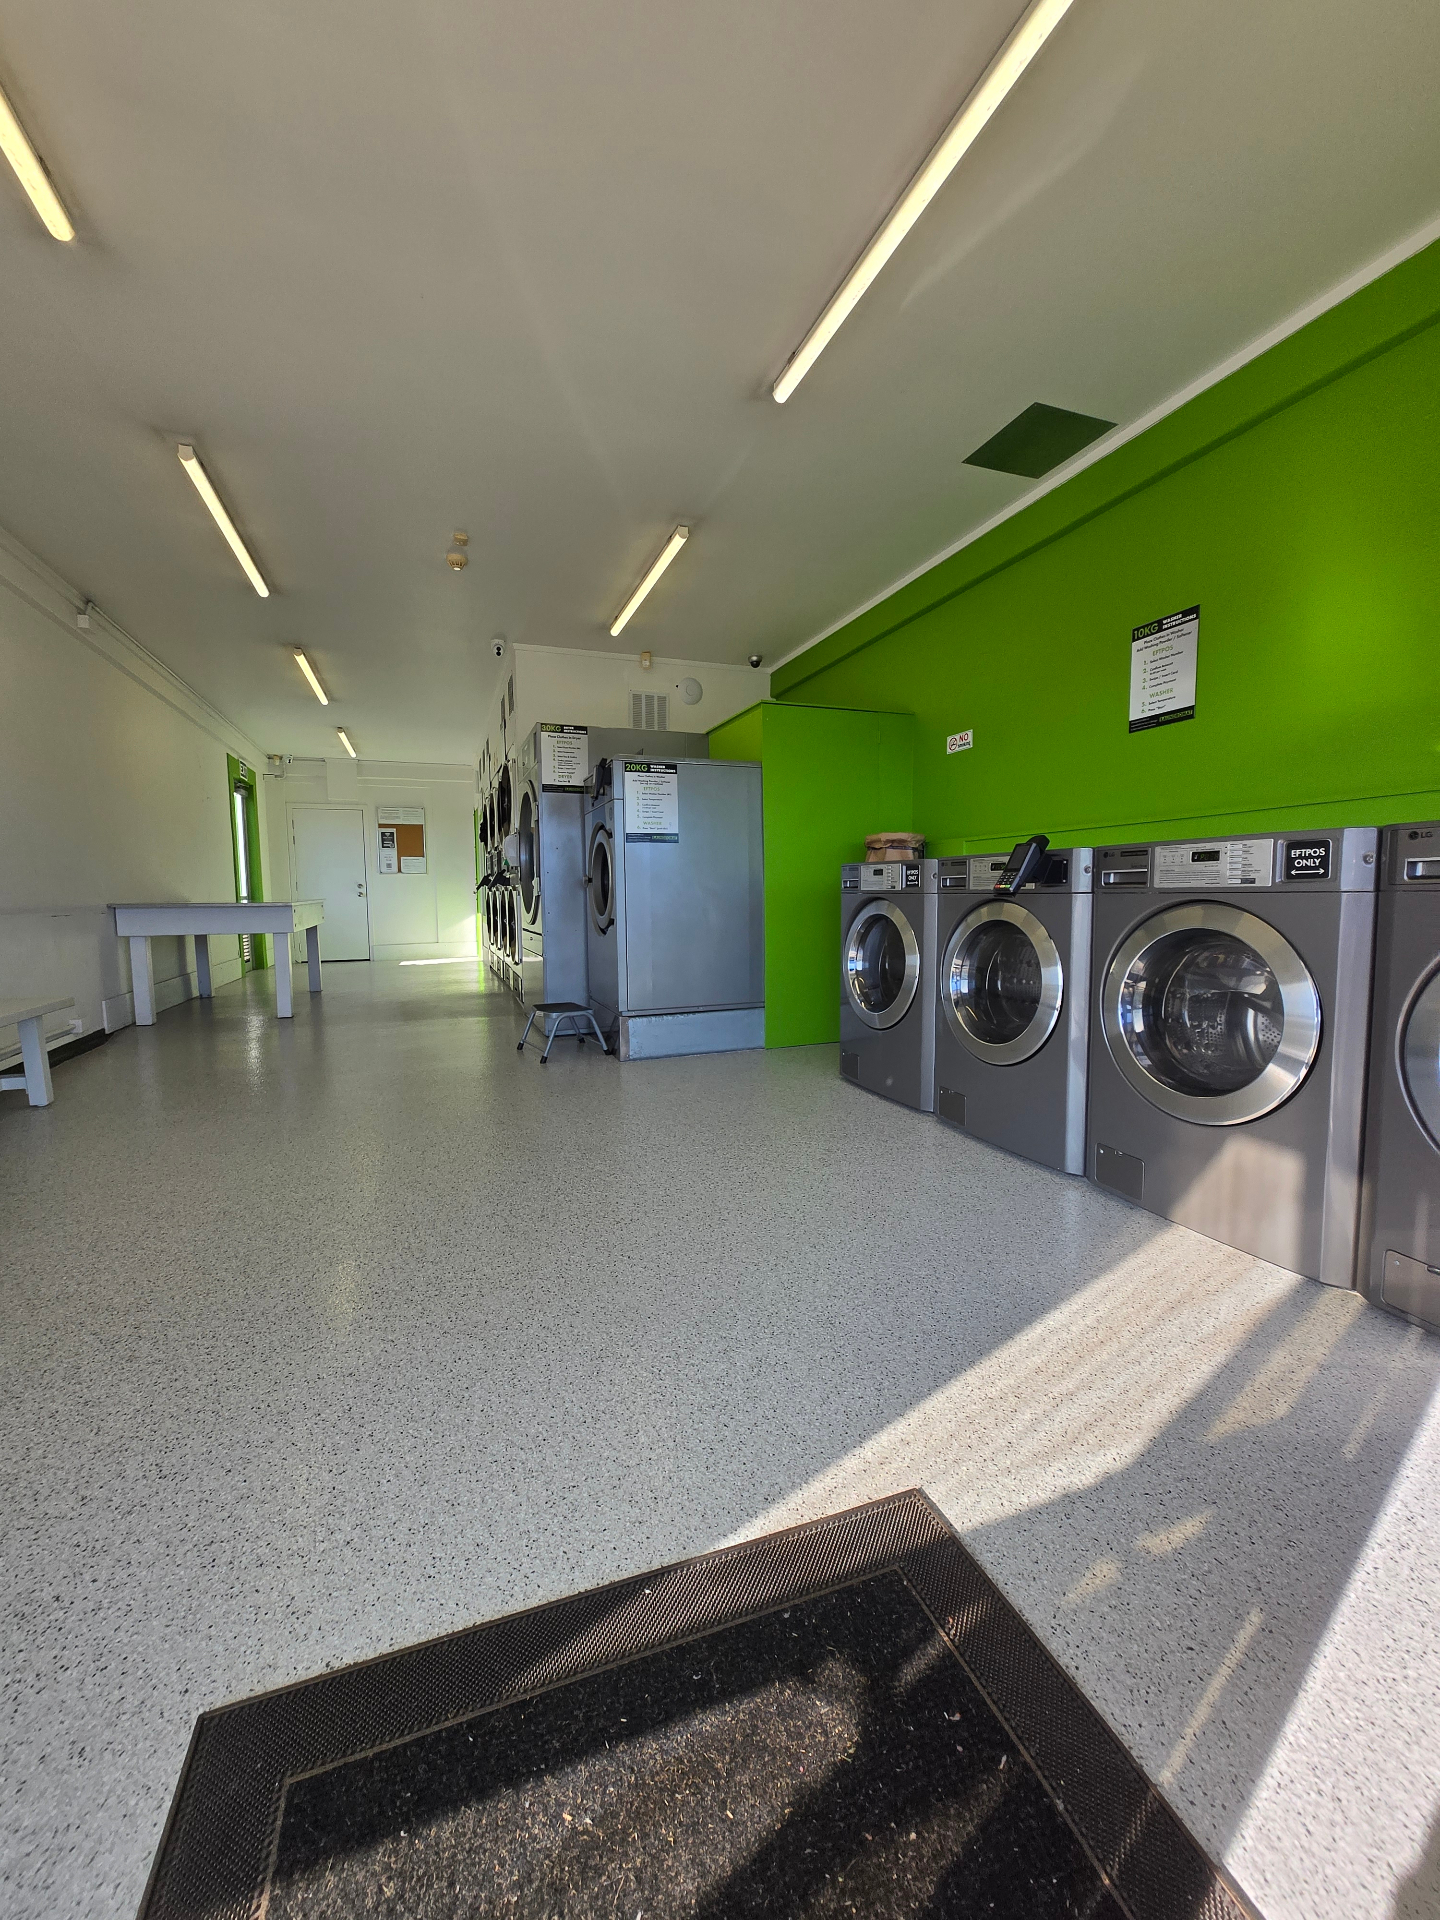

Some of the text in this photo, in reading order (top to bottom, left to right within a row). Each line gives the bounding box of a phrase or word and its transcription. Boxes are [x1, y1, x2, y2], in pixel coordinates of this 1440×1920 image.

[1163, 614, 1182, 624] WASHER
[1163, 614, 1197, 629] INSTRUCTIONS
[1134, 624, 1158, 639] 10KG
[1153, 645, 1173, 656] EFTPOS
[1149, 688, 1173, 698] WASHER
[959, 733, 968, 742] NO
[1291, 848, 1326, 858] EFTPOS
[1294, 859, 1321, 867] ONLY
